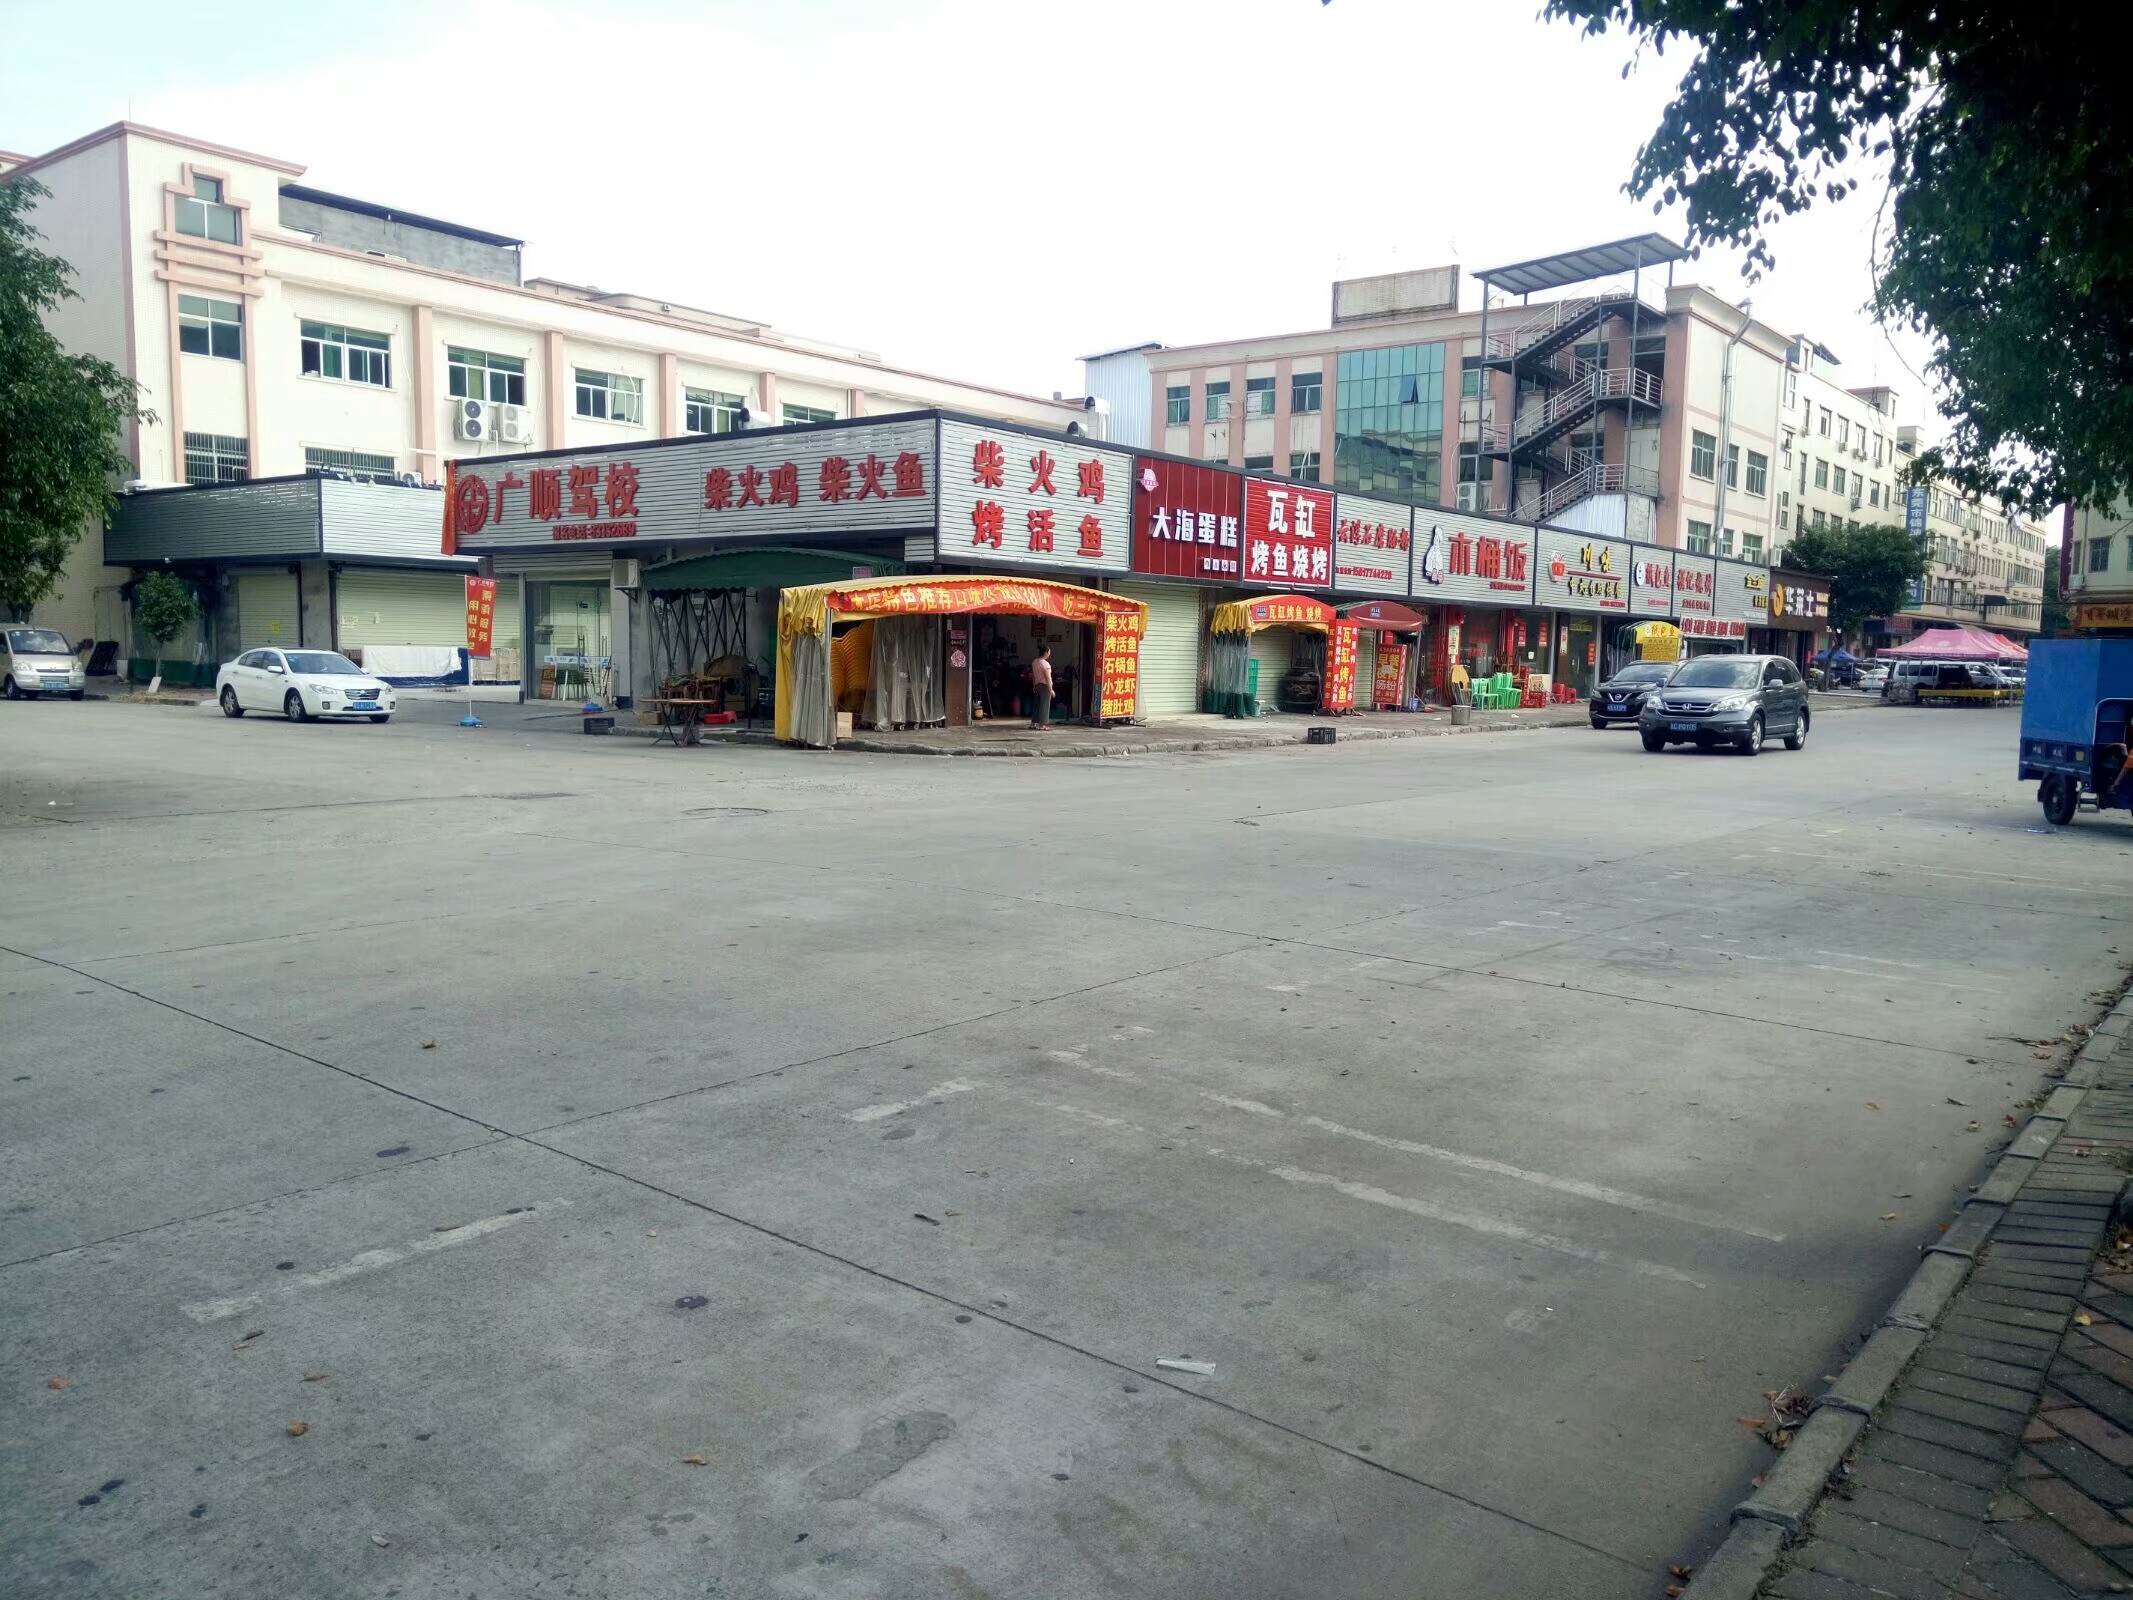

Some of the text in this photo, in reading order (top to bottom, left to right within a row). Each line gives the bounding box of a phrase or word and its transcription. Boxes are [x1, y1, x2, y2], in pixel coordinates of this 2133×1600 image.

[494, 462, 640, 523] 广顺驾校
[704, 452, 926, 511] 柴火鸡 柴火鱼
[972, 440, 1104, 504] 柴火鸡
[972, 500, 1104, 557] 烤活鱼
[1152, 507, 1238, 548] 大海蛋糕
[1267, 490, 1316, 538] 瓦缸
[1252, 540, 1327, 580] 烤鱼烧烤
[1449, 532, 1528, 580] 木桶饭
[1106, 614, 1138, 632] 柴火鸡
[1269, 604, 1303, 620] 瓦缸烤鱼
[1306, 606, 1322, 621] 烧烤
[1105, 636, 1137, 653] 烤活鱼
[1103, 677, 1135, 695] 小龙虾
[1104, 657, 1136, 674] 石锅鱼
[1338, 627, 1351, 704] 瓦缸烤鱼
[1102, 698, 1134, 716] 猪肚鸡
